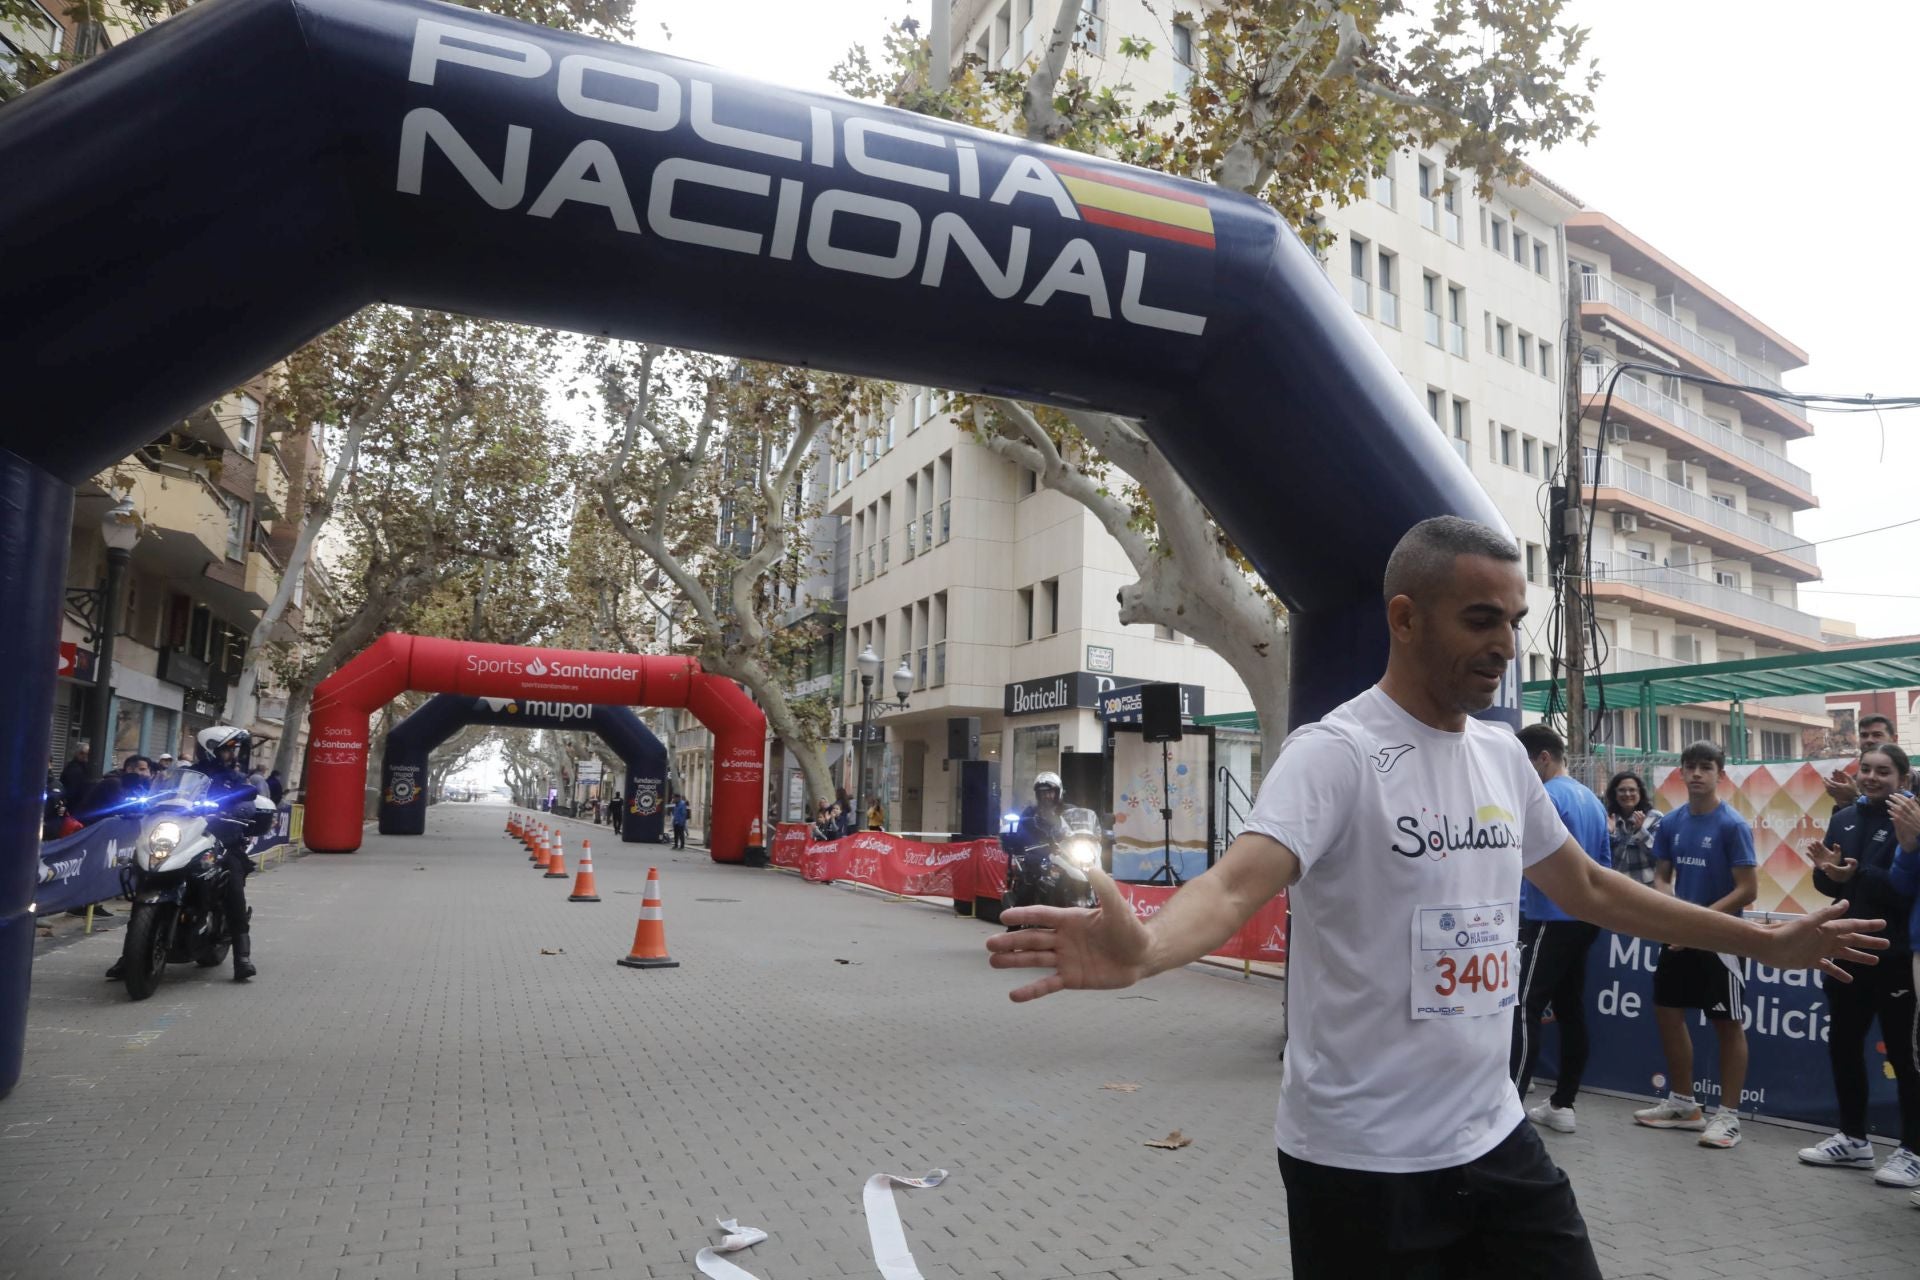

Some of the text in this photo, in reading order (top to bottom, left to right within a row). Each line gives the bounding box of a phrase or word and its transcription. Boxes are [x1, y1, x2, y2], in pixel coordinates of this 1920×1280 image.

[396, 106, 1208, 336] NACIONAL
[466, 655, 640, 681] Sports Santander
[1012, 678, 1068, 713] Botticelli
[1121, 693, 1143, 703] POLIC
[1122, 702, 1143, 712] NACIO
[525, 699, 593, 722] mupol
[324, 727, 353, 737] Sports
[321, 740, 363, 749] Santander
[732, 747, 757, 757] Sports
[1435, 950, 1509, 997] 3401
[1597, 981, 1642, 1018] de
